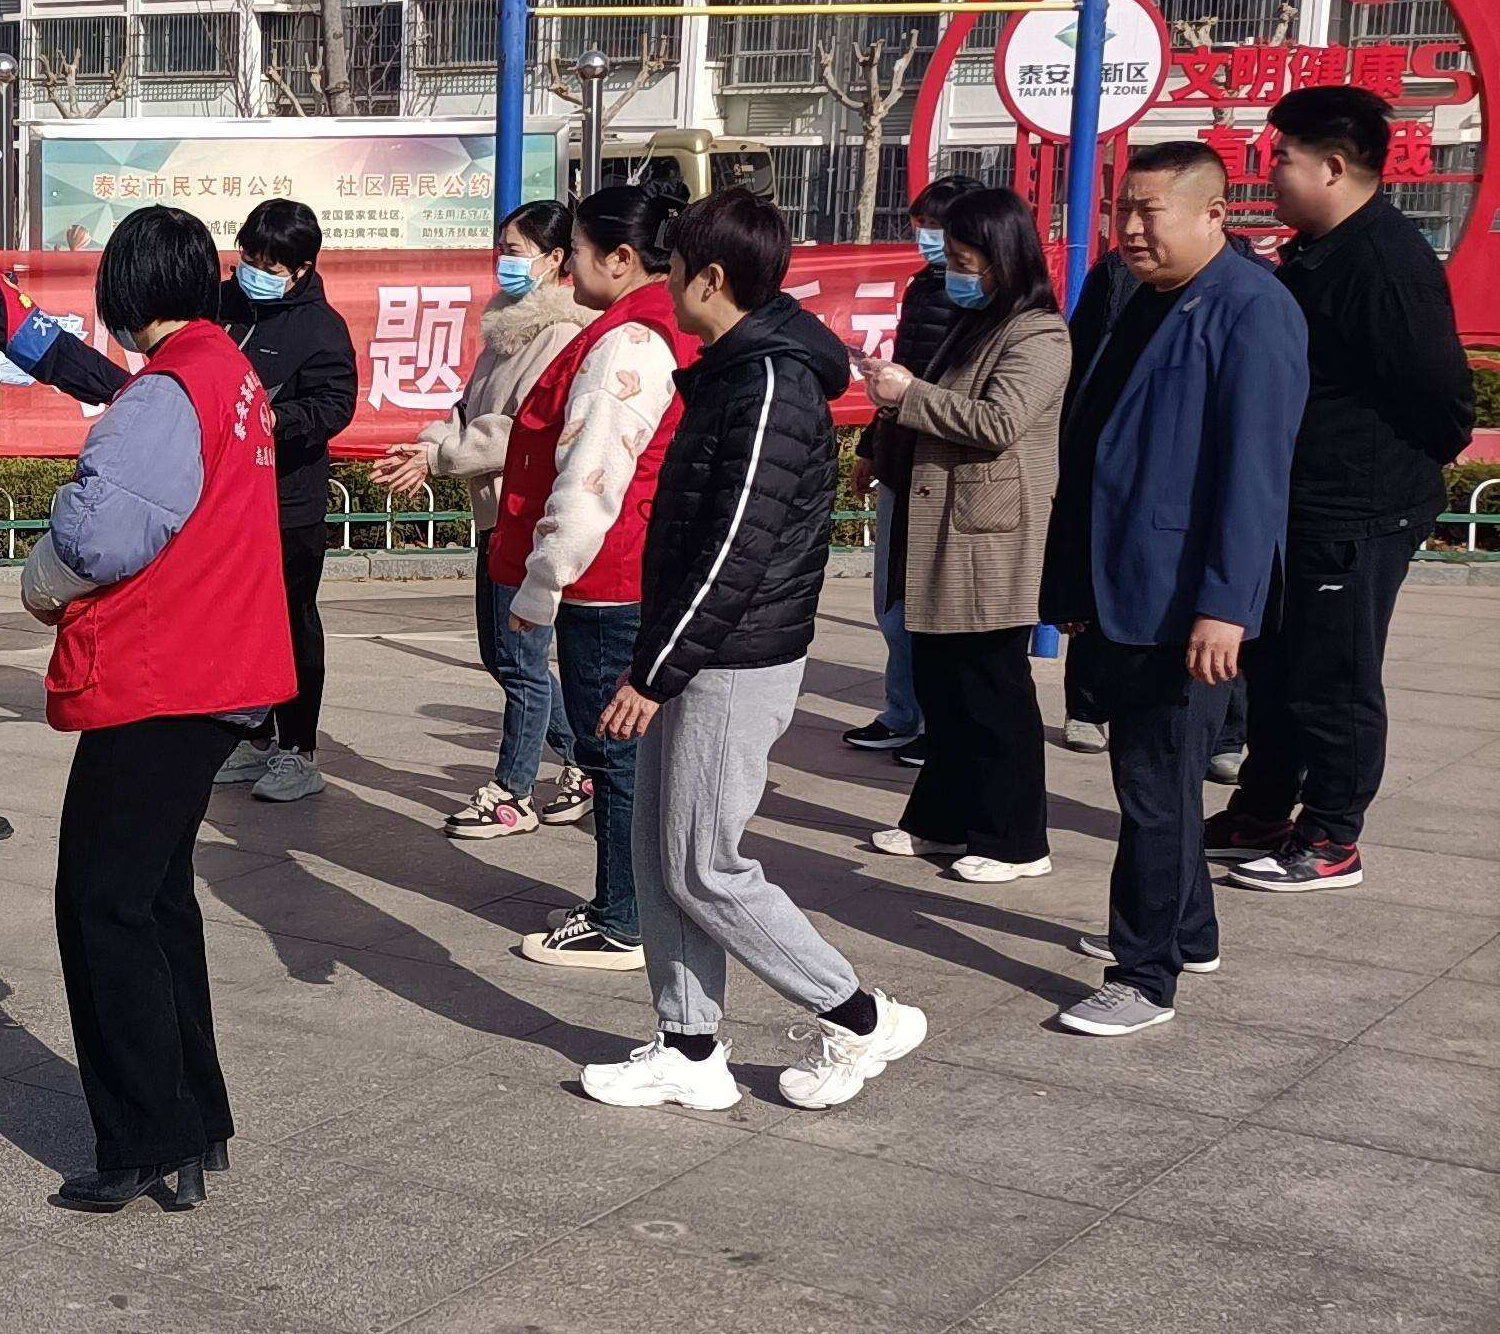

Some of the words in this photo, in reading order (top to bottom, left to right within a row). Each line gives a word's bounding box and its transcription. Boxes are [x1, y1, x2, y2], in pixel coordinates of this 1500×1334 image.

[1018, 62, 1150, 85] 泰安新区
[1169, 41, 1408, 102] 文明健康
[1113, 85, 1148, 96] ZONE
[95, 174, 293, 198] 泰安市民文明公约
[336, 174, 493, 198] 社区居民公约
[367, 286, 472, 411] 题
